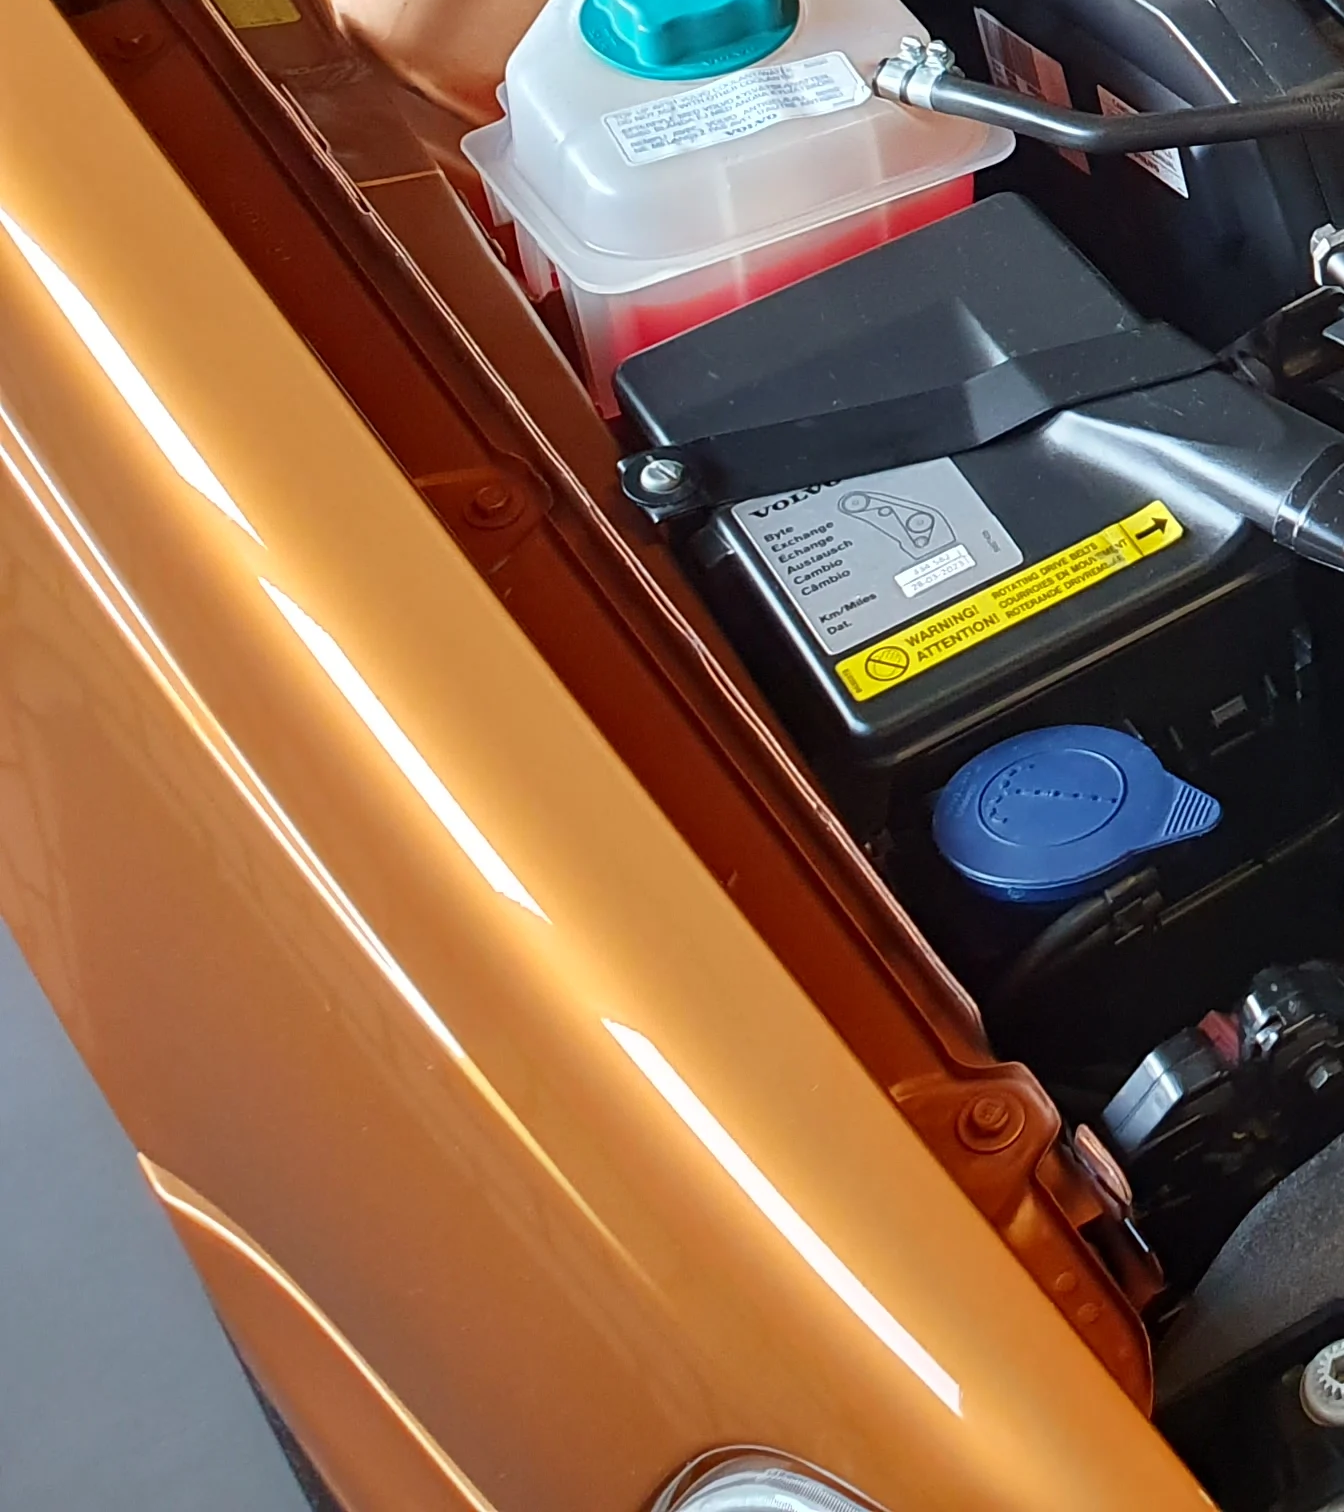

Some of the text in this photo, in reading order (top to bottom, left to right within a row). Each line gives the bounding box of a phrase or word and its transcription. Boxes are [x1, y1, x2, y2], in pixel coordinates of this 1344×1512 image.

[725, 113, 777, 136] VOLVO
[764, 526, 794, 543] Byte
[771, 521, 834, 553] Exchange
[787, 539, 853, 575] Austausch
[793, 559, 843, 585] Cambio
[991, 542, 1098, 599] ROTATING DRIVE BELTS
[998, 539, 1129, 609] COURROIES EN MOUMNT
[819, 593, 877, 623] Km/Miles
[1005, 585, 1064, 619] ROTERANDE
[827, 621, 853, 635] Dat.
[904, 605, 980, 647] WARNING!
[917, 613, 1001, 662] ATTENTION!
